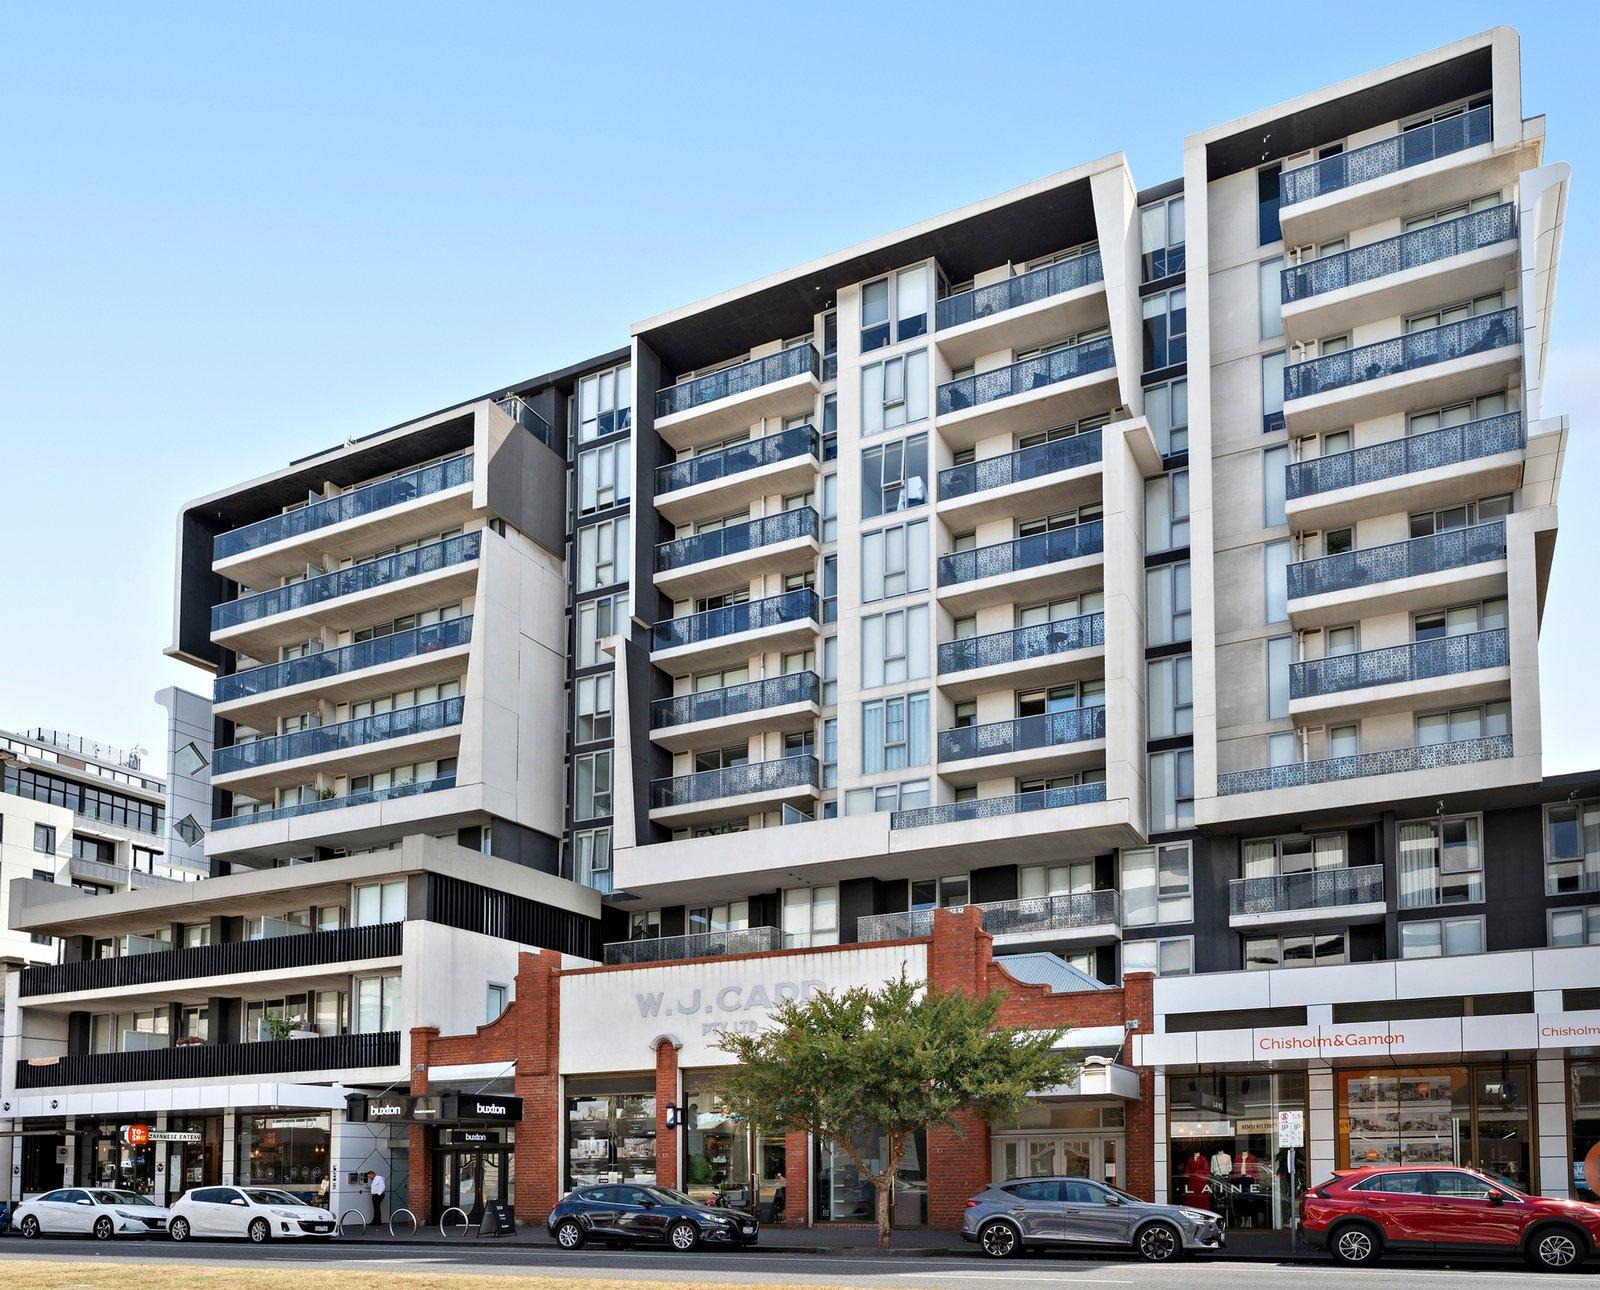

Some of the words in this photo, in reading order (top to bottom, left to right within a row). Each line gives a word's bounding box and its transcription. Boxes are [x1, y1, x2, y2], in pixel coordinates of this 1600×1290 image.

[733, 1020, 759, 1034] LTD
[1259, 1033, 1405, 1050] Chisholm&Gamon
[370, 1104, 401, 1116] buxton
[476, 1103, 506, 1115] buxton
[465, 1133, 486, 1141] buxton
[1184, 1183, 1261, 1194] LAINE
